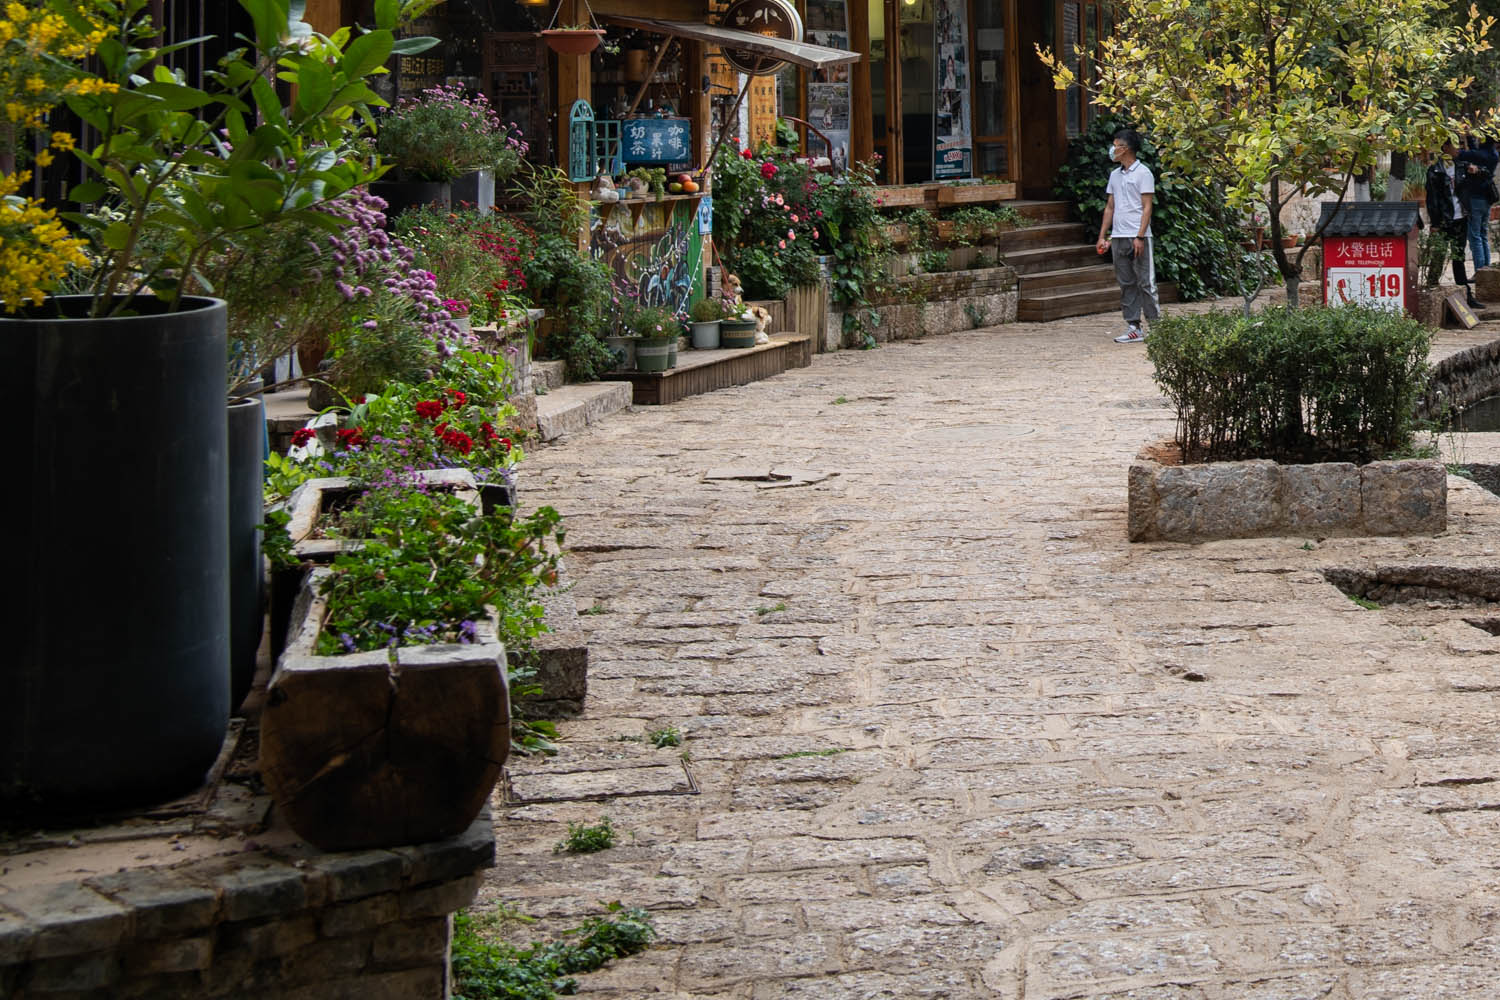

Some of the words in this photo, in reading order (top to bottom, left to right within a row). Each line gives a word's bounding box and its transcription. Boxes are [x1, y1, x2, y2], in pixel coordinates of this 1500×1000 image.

[630, 126, 646, 155] 奶茶
[651, 132, 664, 160] 果汁
[668, 124, 684, 150] 咖啡
[1336, 241, 1394, 258] 火警电话
[1366, 274, 1400, 298] 119
